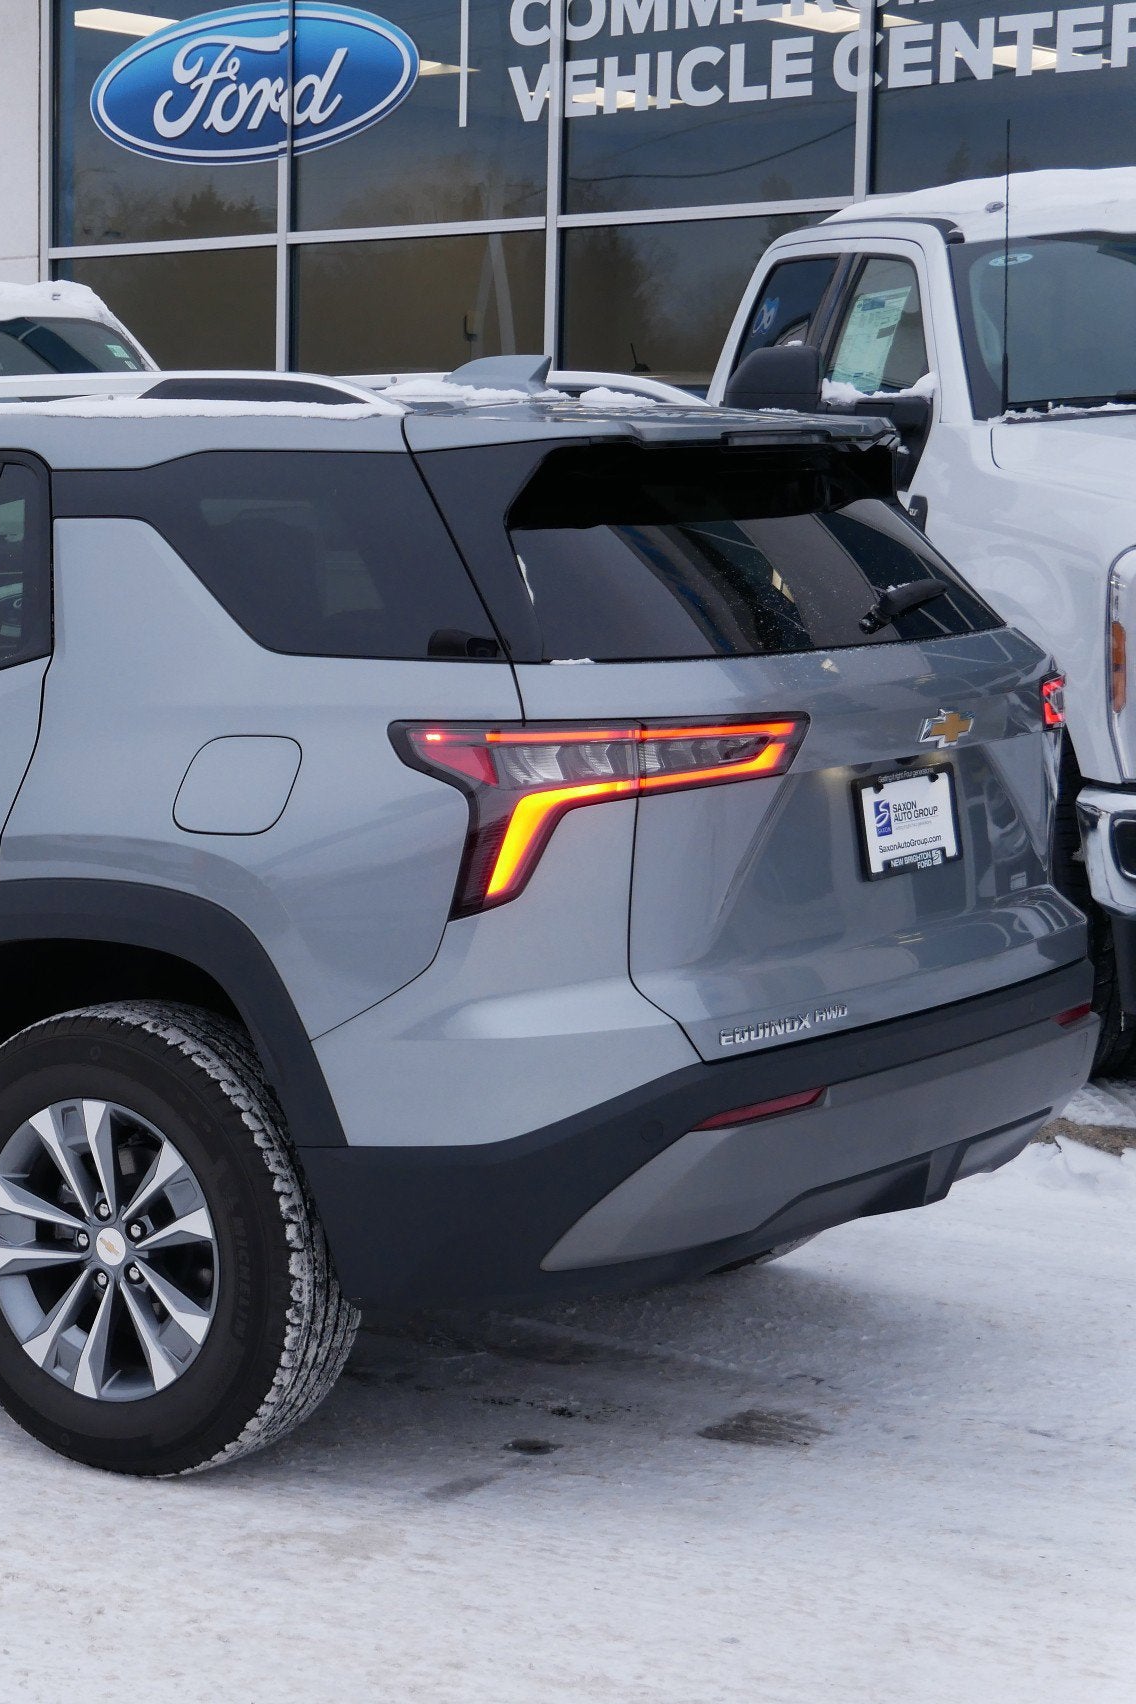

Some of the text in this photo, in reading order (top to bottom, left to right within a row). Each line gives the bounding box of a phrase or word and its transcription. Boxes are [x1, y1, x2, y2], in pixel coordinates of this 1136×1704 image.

[153, 30, 349, 139] Ford
[508, 37, 814, 122] VEHICLE
[892, 801, 917, 813] SAXON
[894, 805, 939, 822] AUTO GROUP
[878, 835, 942, 853] SaxonAutoGroup.com
[720, 1004, 848, 1046] EQUINOX AWD
